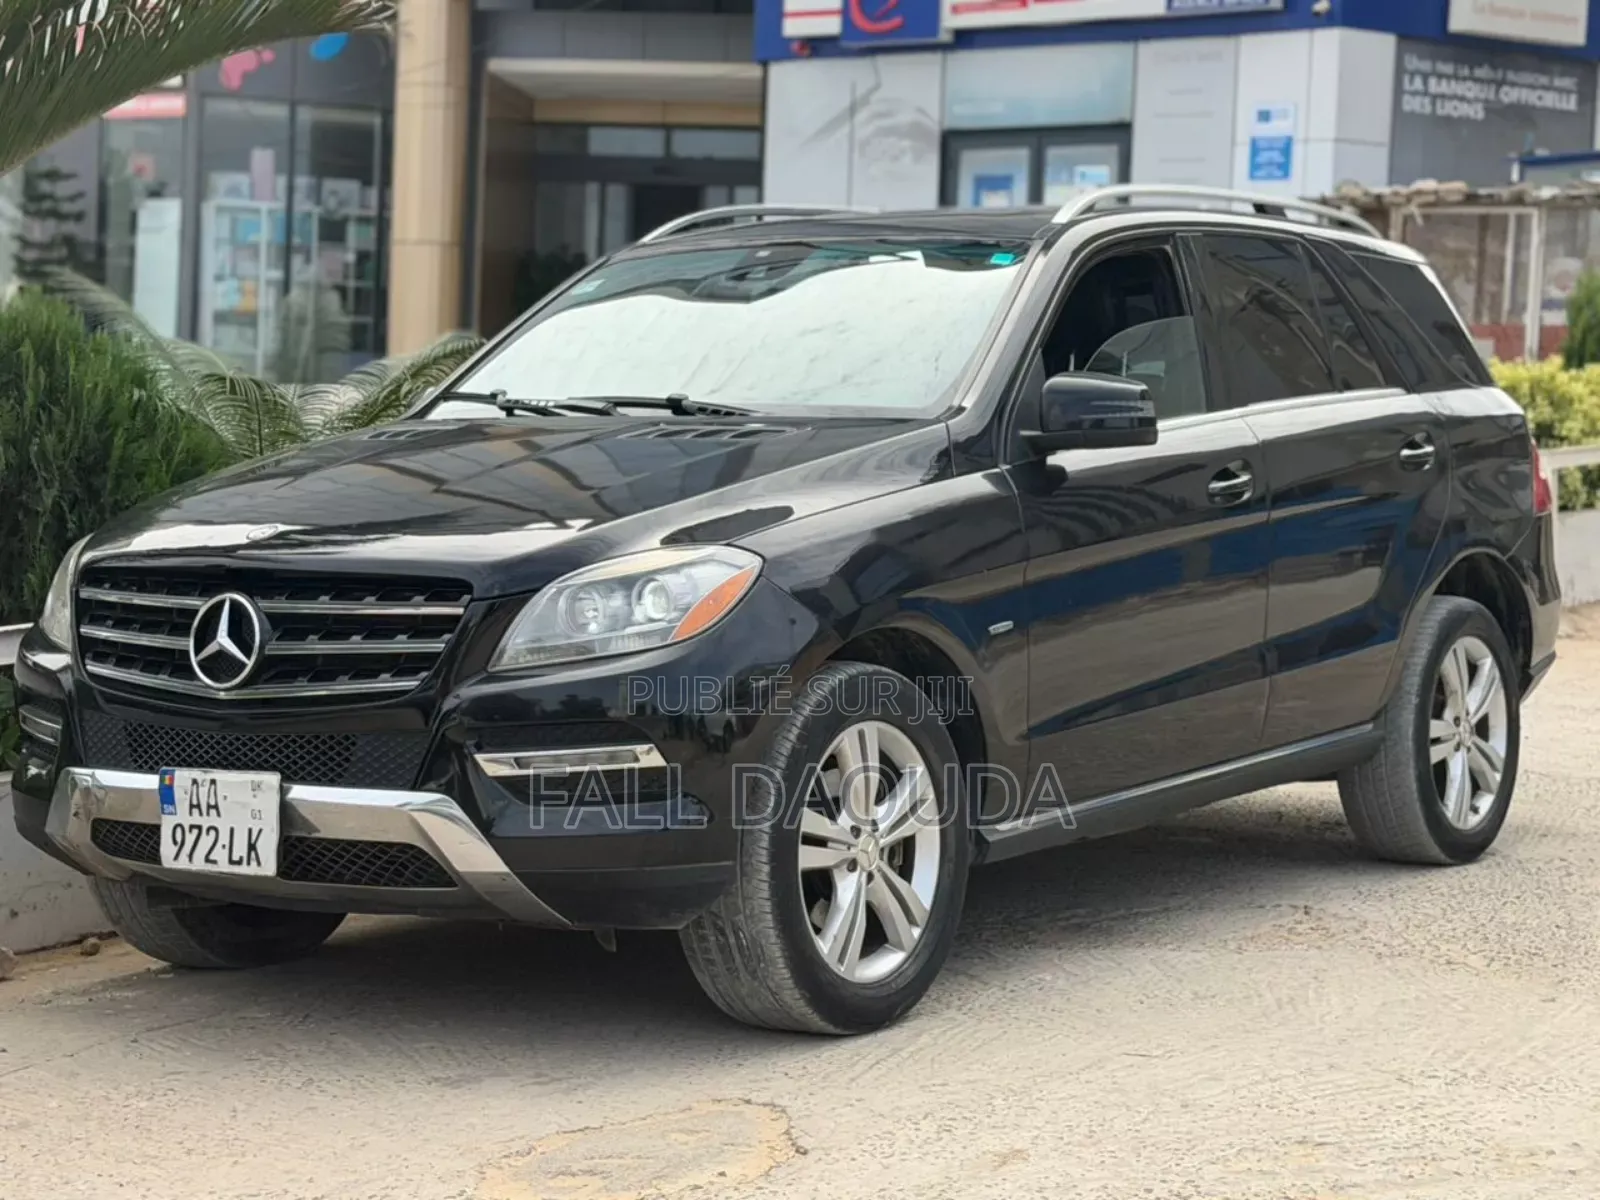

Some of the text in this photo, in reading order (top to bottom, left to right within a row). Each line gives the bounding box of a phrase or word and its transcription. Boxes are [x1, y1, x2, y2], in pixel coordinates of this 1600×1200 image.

[1402, 94, 1486, 121] DES LIONS
[1403, 74, 1579, 112] LA BANQUE OFFICIELLE
